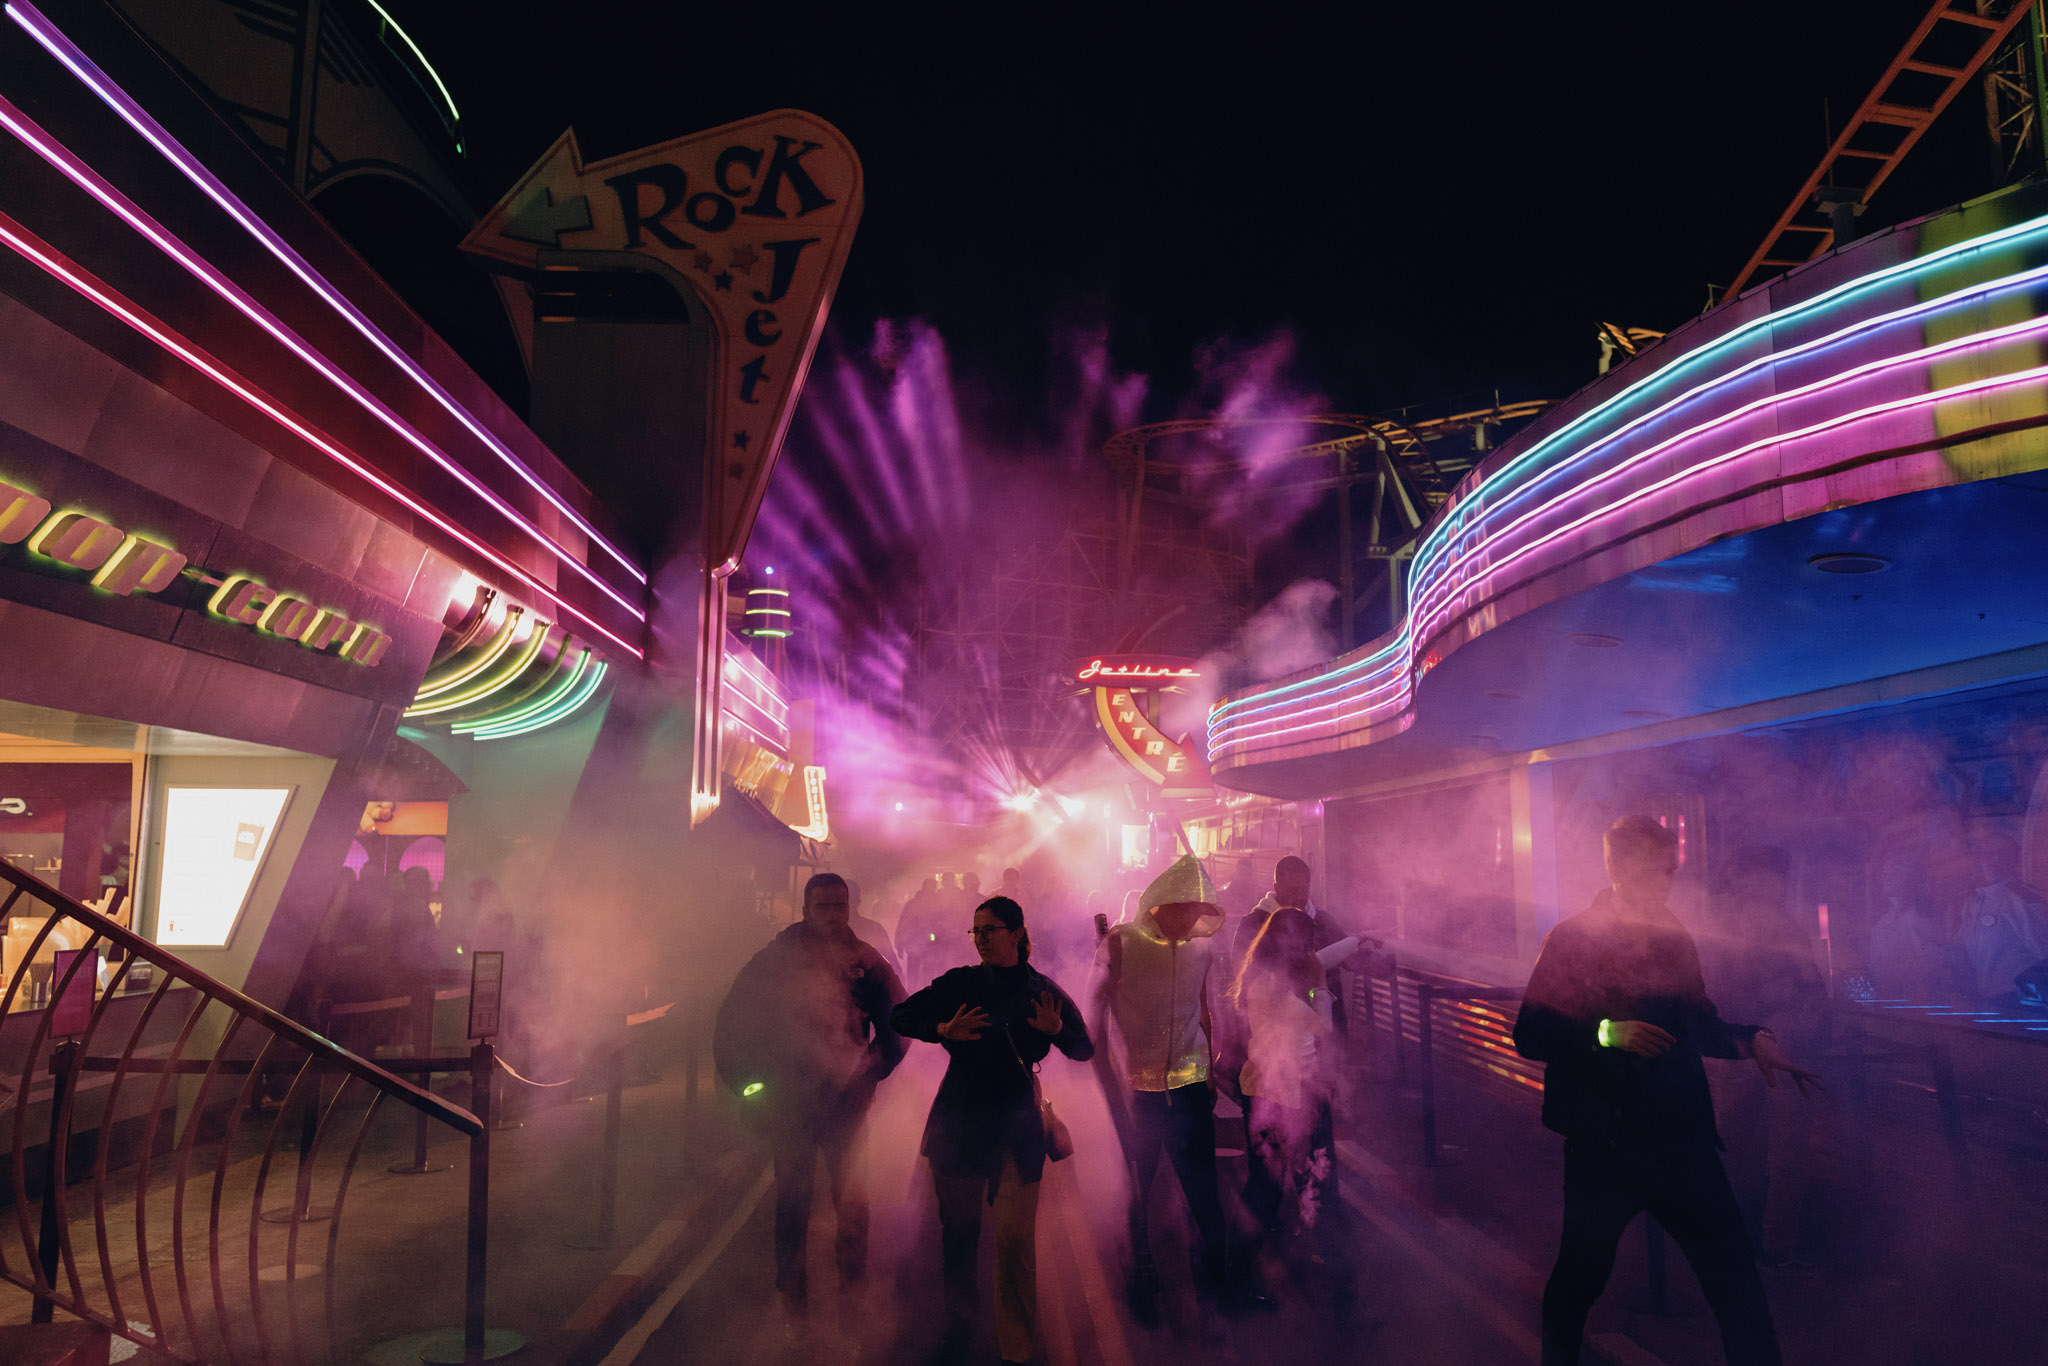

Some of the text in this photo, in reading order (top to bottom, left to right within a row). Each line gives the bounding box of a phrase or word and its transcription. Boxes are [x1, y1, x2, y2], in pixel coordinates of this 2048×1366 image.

[740, 237, 821, 404] Jet
[1079, 660, 1201, 679] Jetline
[1112, 693, 1187, 772] ENTRÉ
